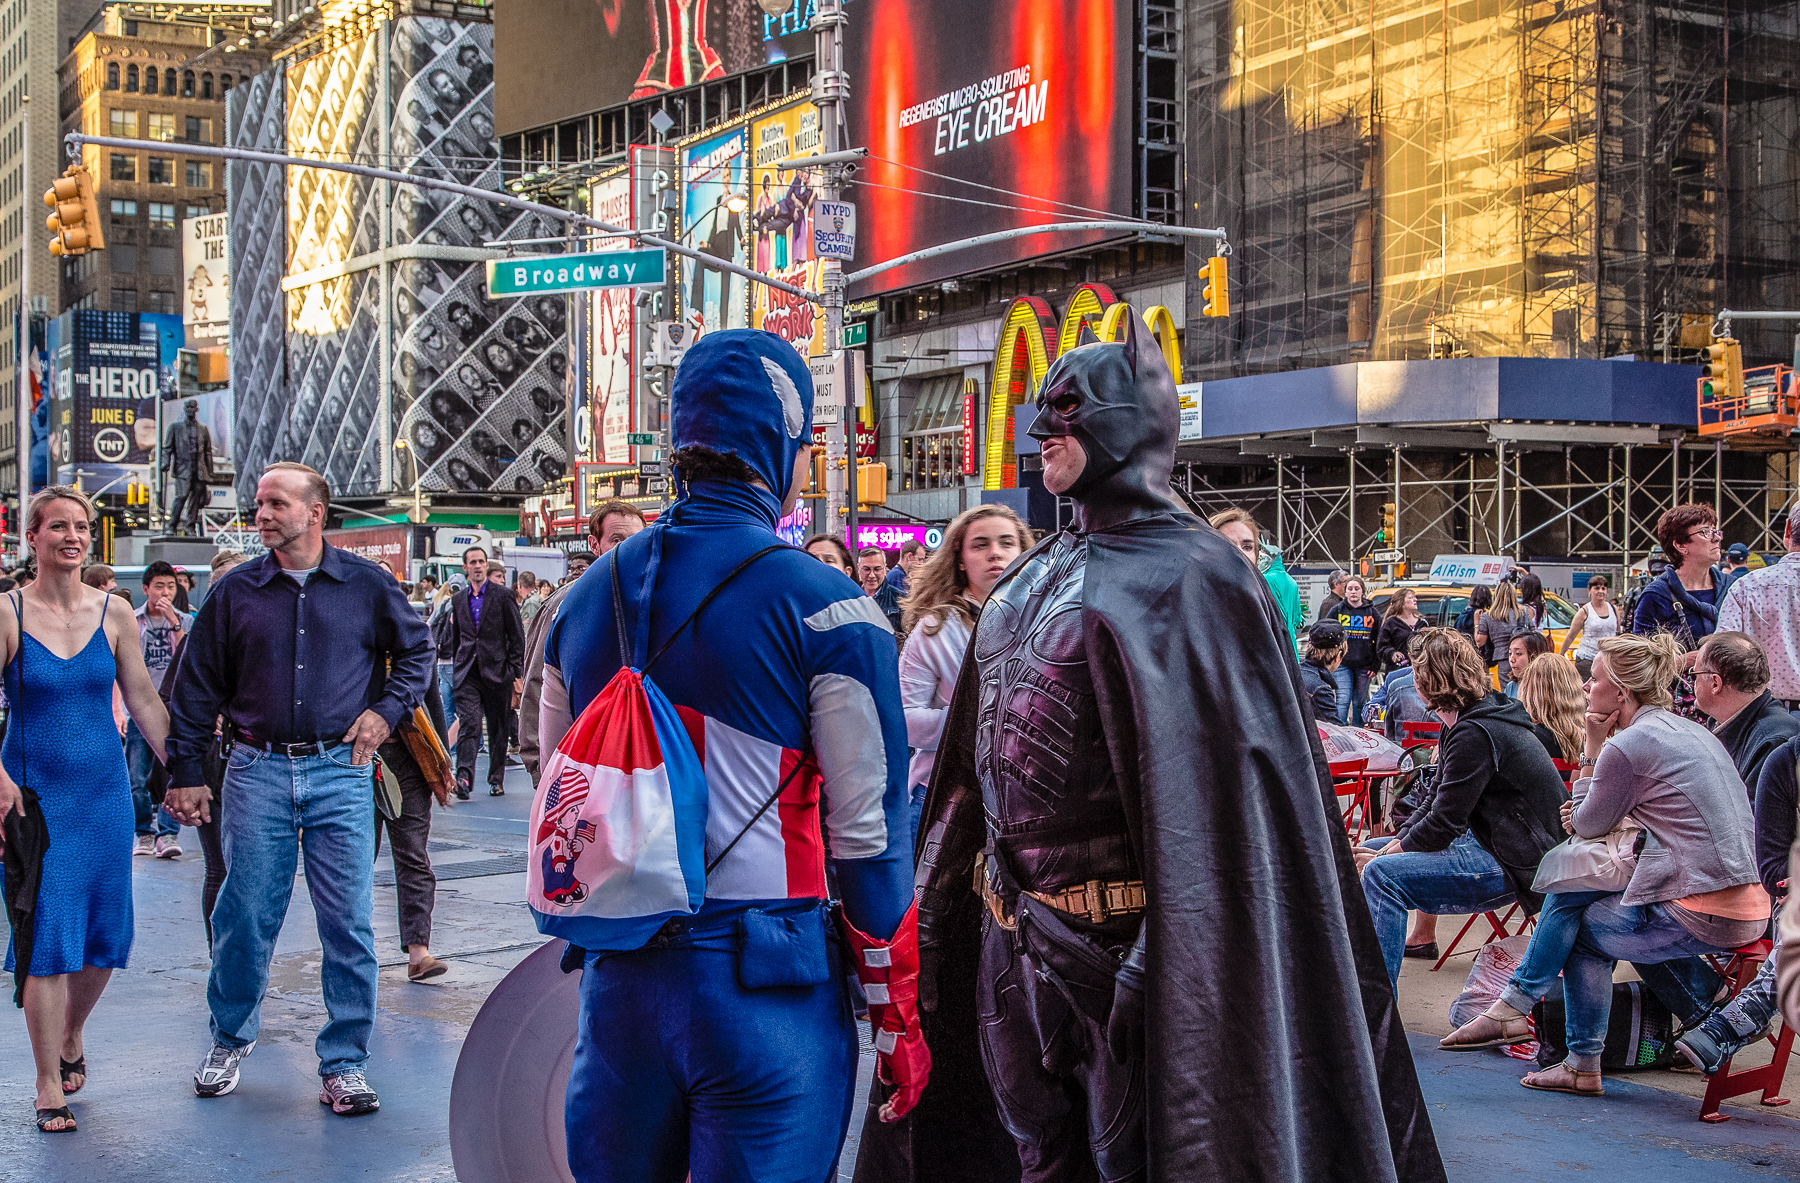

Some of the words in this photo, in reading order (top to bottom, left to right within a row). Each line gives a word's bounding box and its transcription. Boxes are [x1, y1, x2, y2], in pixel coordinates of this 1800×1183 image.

[899, 94, 949, 128] REGENERIST
[949, 64, 1031, 111] MICRO-SCULPTING
[934, 106, 972, 156] EYE
[975, 80, 1049, 143] CREAM
[795, 128, 822, 153] MUELLER
[688, 154, 711, 183] JANE
[711, 134, 742, 171] LYNCH
[756, 139, 790, 167] BRODERICK
[822, 203, 851, 217] NYPD
[203, 240, 224, 260] THE
[514, 262, 636, 287] Broadway
[769, 269, 808, 313] NICE
[763, 302, 814, 343] WORK
[847, 327, 853, 344] 7
[811, 365, 824, 376] RIGHT
[75, 373, 90, 384] THE
[90, 366, 157, 399] HERO
[816, 383, 832, 397] MUST
[90, 408, 123, 424] JUNE
[124, 409, 134, 425] 6
[823, 404, 838, 416] RIGHT
[98, 439, 124, 452] TNT
[628, 434, 634, 445] W
[635, 433, 644, 445] 46
[643, 465, 657, 473] ONE
[568, 540, 588, 553] OFFICE
[1431, 564, 1477, 579] AIRism
